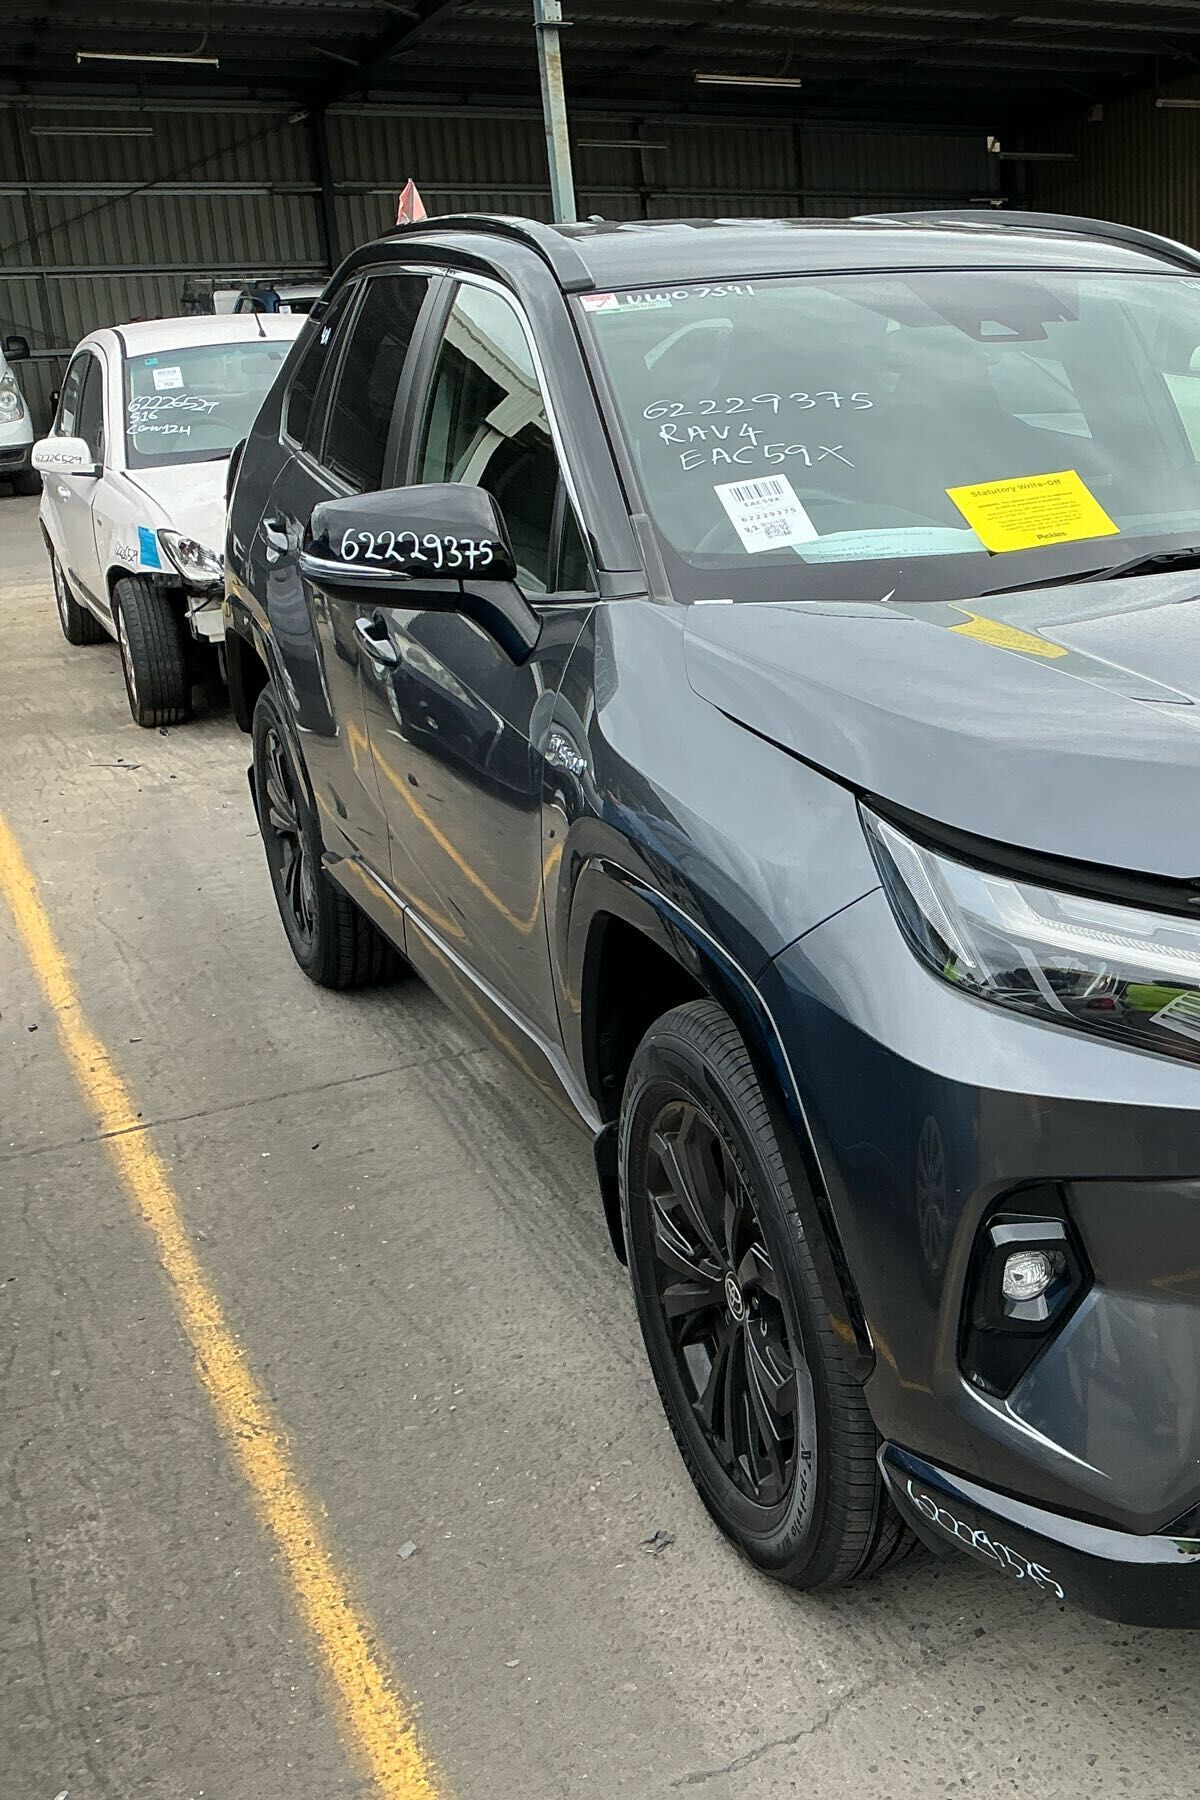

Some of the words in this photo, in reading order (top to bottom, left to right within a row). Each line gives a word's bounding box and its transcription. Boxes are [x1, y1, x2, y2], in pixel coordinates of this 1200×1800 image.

[643, 391, 874, 419] 62229375
[659, 423, 763, 446] RAV4
[679, 443, 855, 471] EAC59X
[971, 485, 1017, 498] Statutory
[1018, 479, 1061, 491] Write-Off
[741, 507, 797, 522] 62229375
[1036, 531, 1067, 540] Pickles
[341, 529, 493, 570] 62229375
